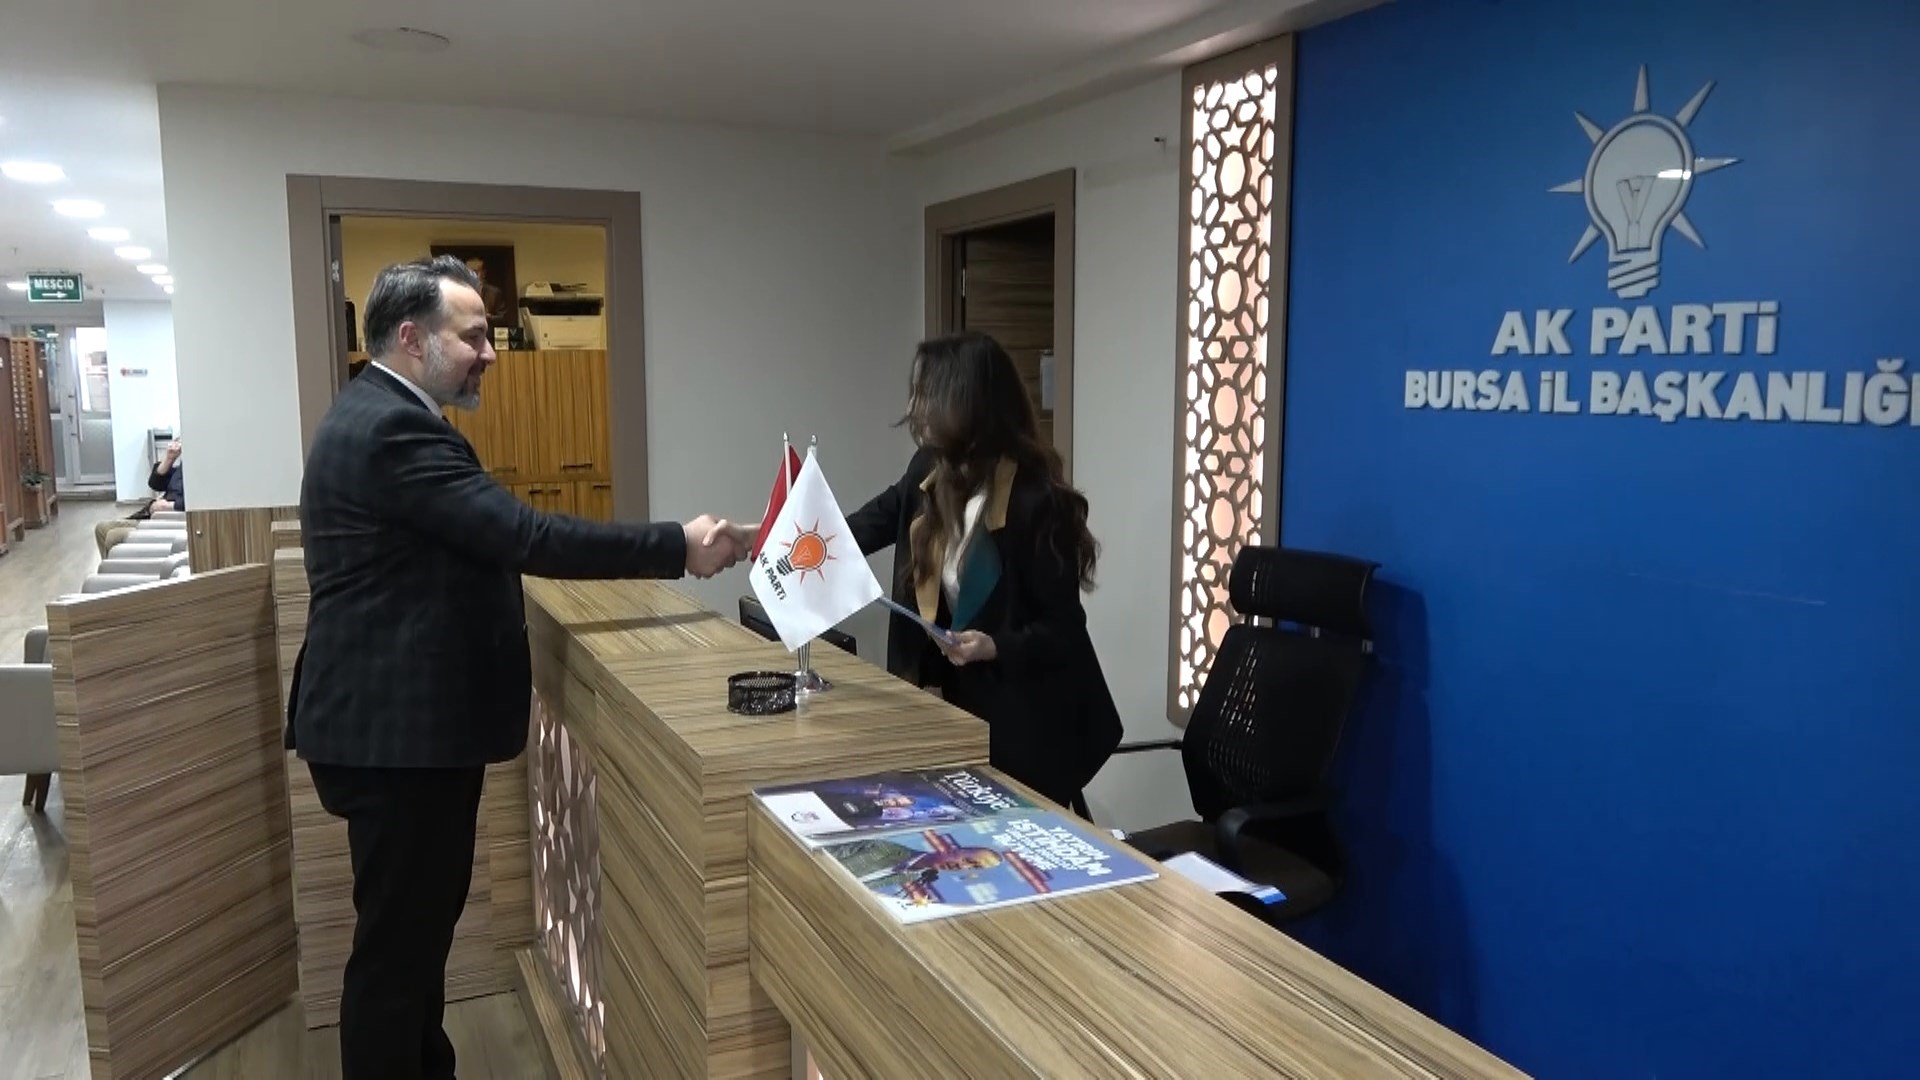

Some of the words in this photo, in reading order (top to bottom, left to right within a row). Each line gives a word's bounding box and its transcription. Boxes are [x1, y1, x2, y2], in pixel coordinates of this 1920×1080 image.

[1490, 309, 1574, 355] AK
[1590, 301, 1780, 355] PARTİ
[1404, 369, 1531, 413] BURSA
[1539, 370, 1581, 414] İL
